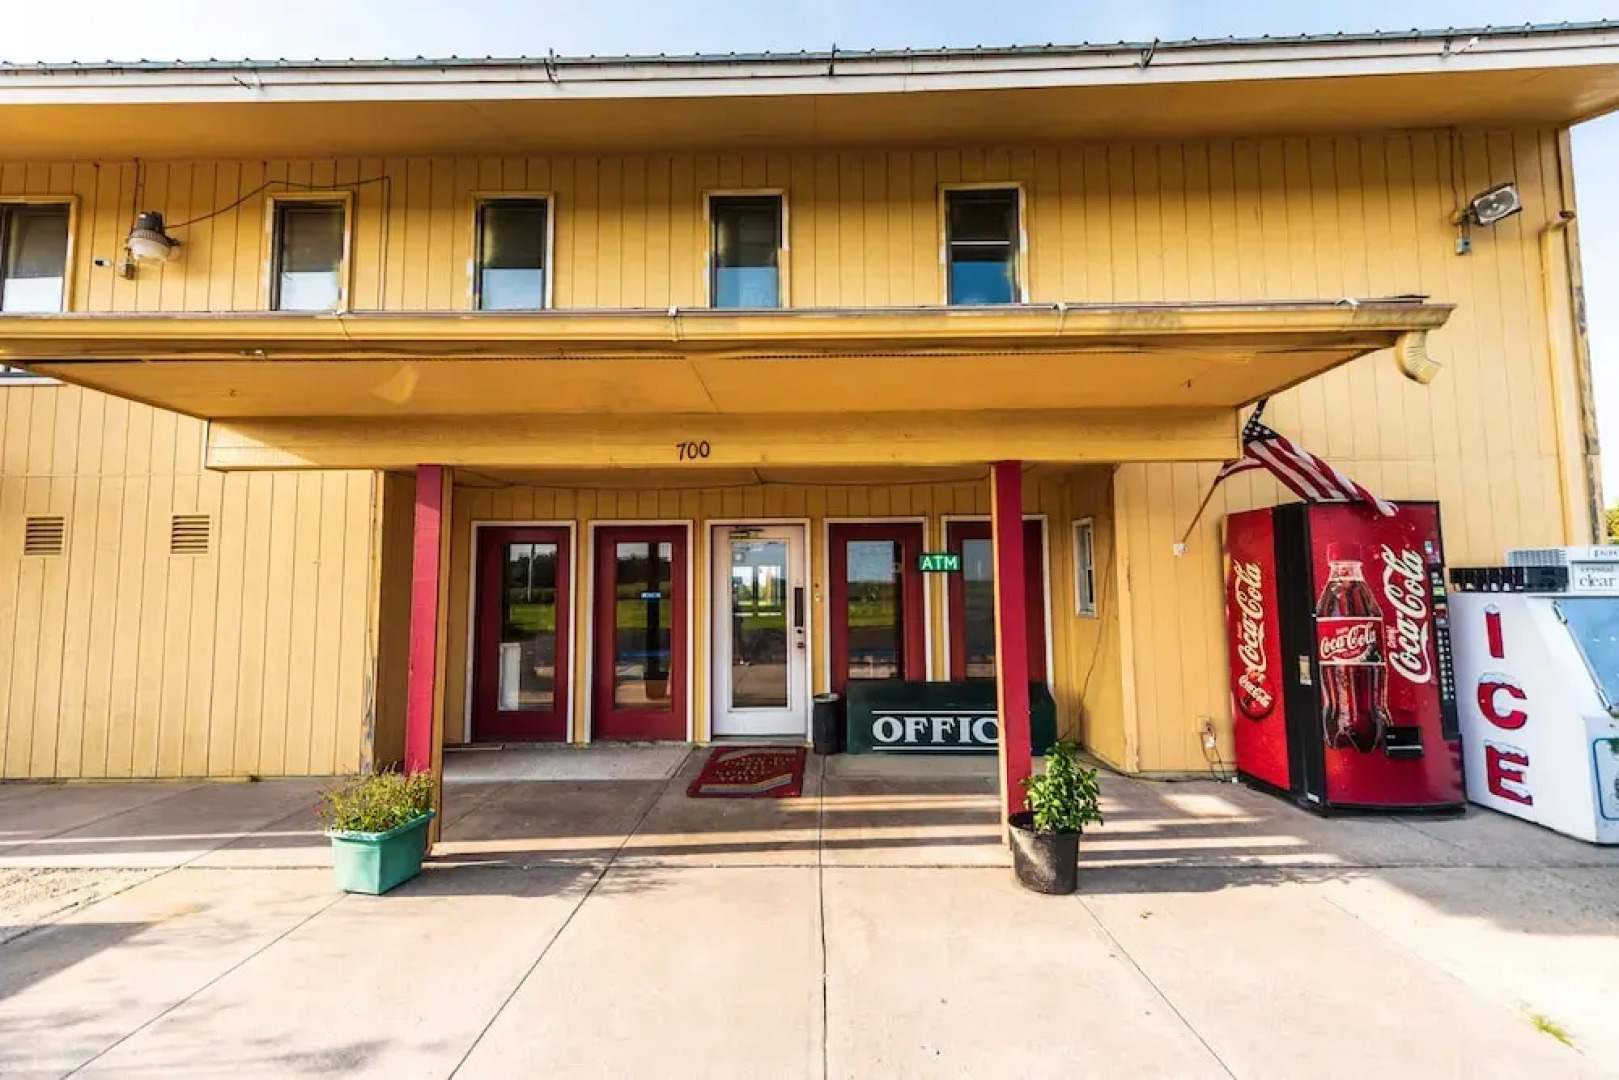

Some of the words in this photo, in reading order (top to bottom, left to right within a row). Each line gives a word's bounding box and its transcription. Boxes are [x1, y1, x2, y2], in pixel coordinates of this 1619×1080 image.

[676, 440, 710, 461] 700
[920, 554, 959, 571] ATM
[1579, 574, 1617, 587] clear
[1381, 544, 1431, 684] Coca-Cola
[1477, 603, 1534, 806] ICE
[872, 716, 1000, 744] OFFIC
